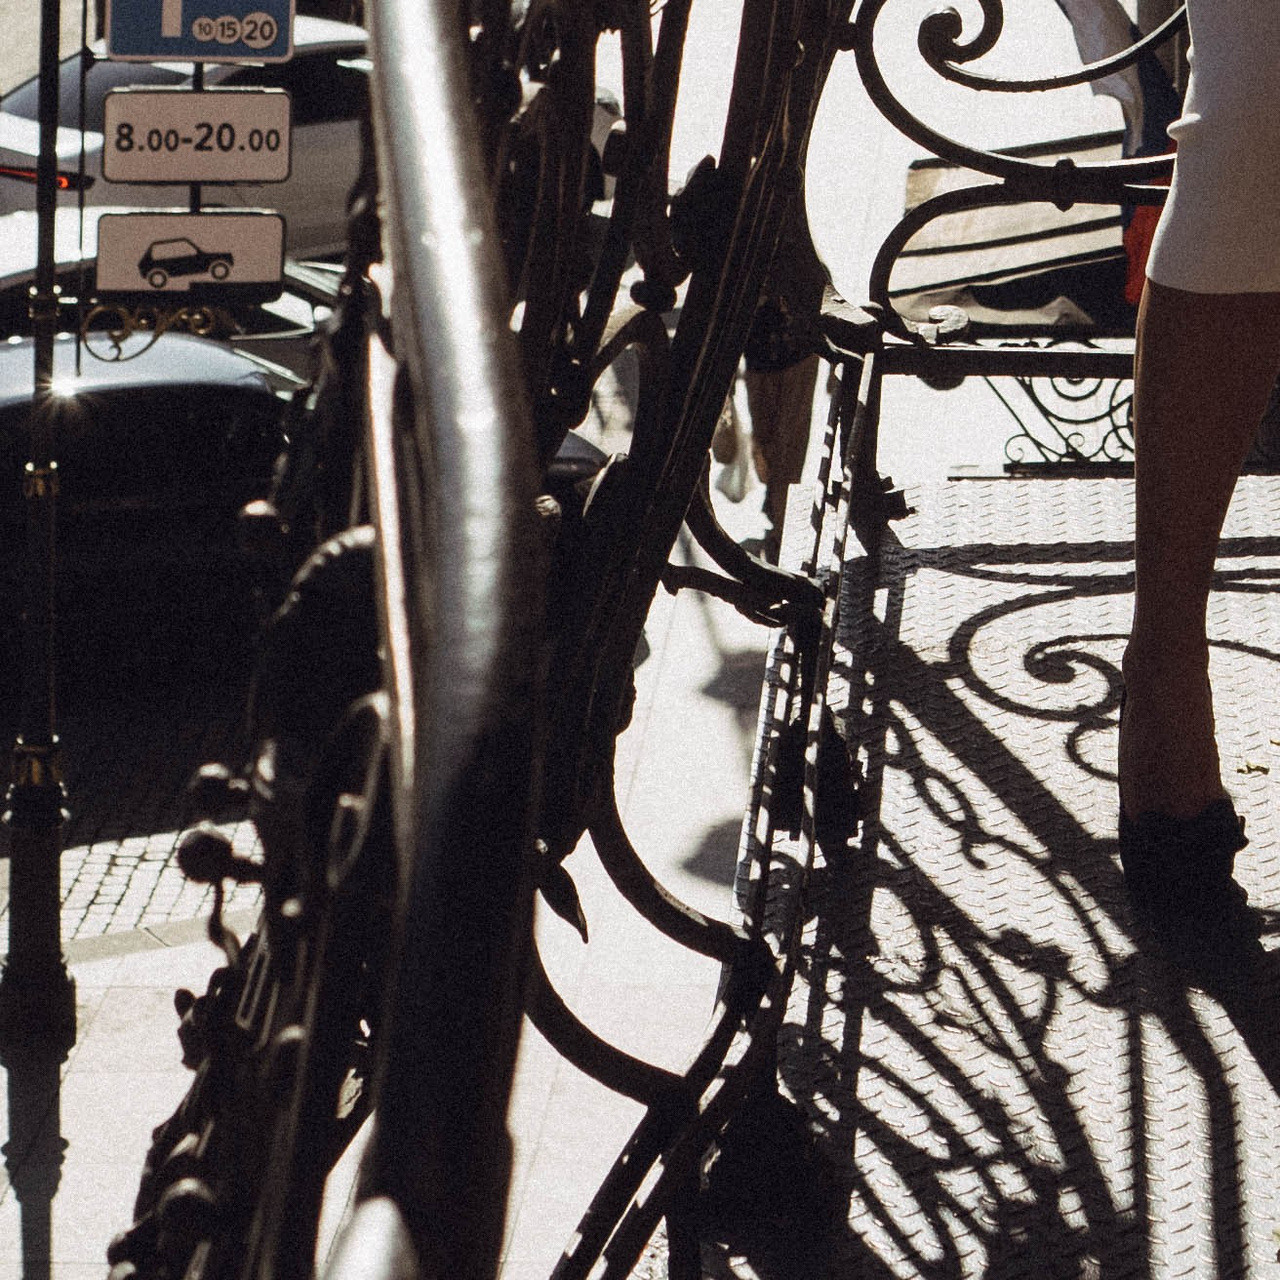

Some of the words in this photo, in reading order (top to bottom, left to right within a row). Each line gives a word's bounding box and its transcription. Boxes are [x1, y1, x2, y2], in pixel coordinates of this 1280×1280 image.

[198, 23, 212, 36] 10
[220, 21, 238, 38] 15
[245, 20, 274, 41] 20
[115, 122, 281, 152] 8.00-20.00
